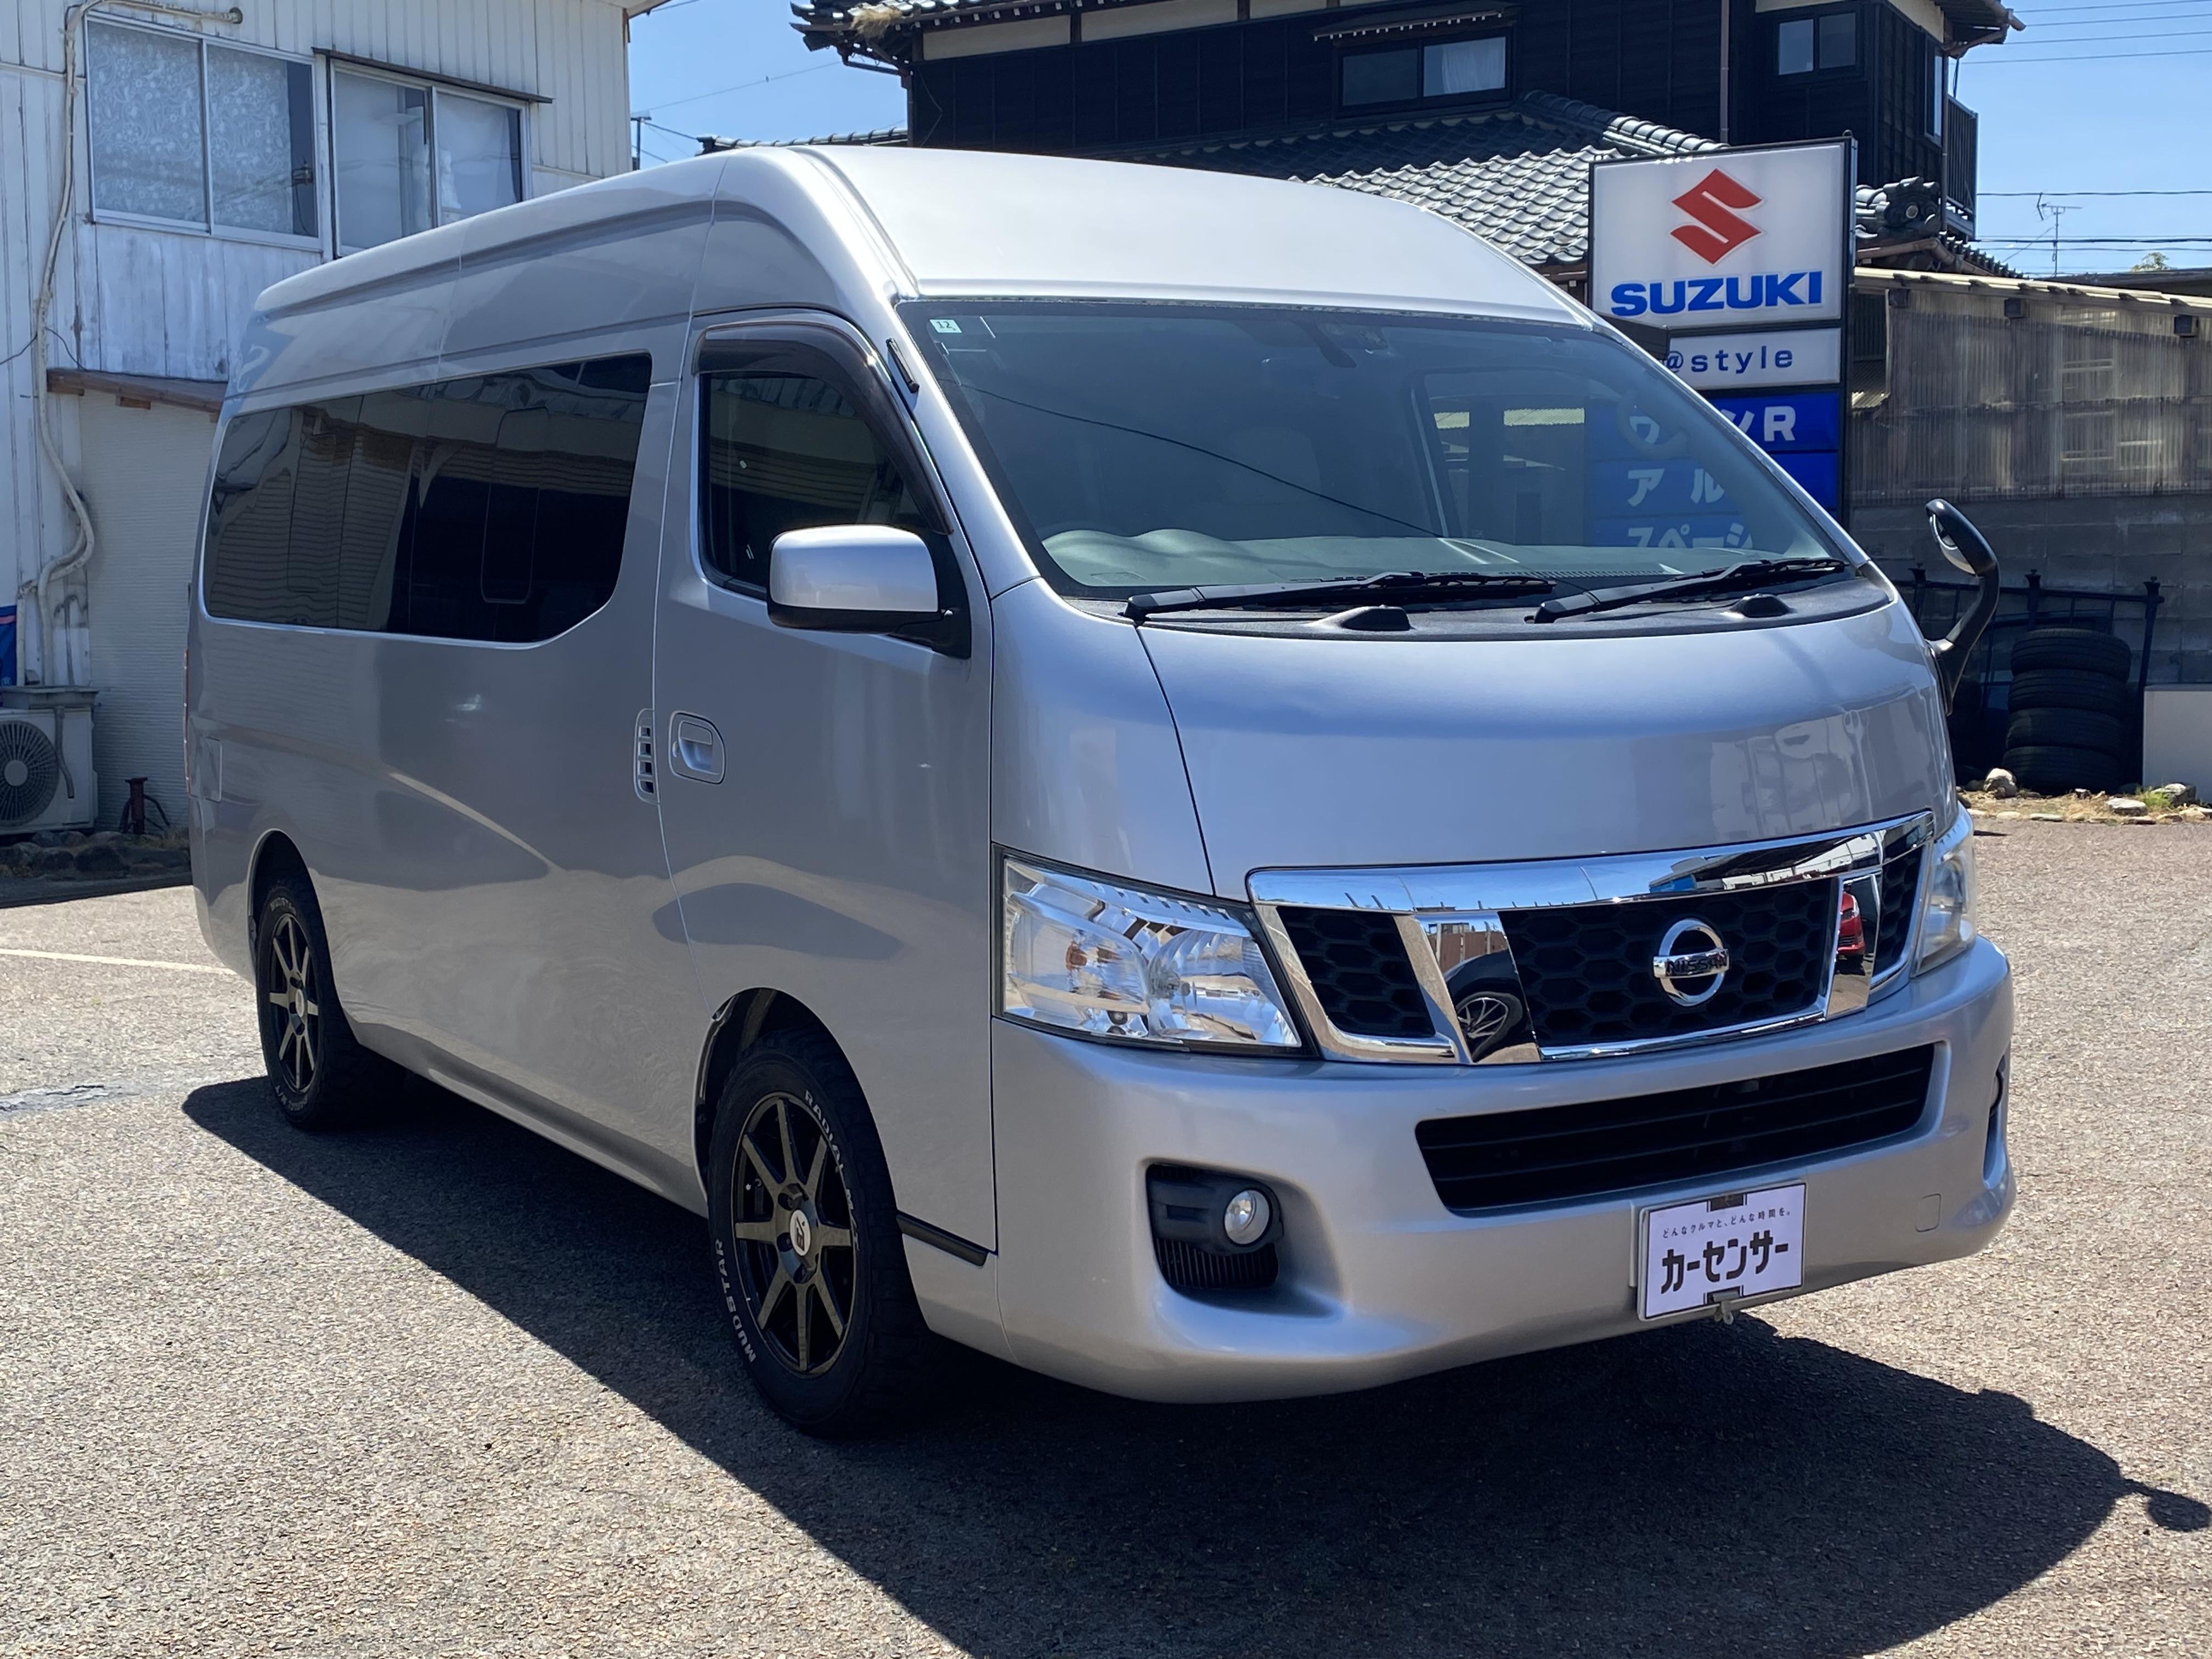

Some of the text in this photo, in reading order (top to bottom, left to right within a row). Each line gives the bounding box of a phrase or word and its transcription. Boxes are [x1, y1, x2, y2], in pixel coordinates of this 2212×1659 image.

[1611, 270, 1822, 317] SUZUKI
[1667, 346, 1793, 374] @style
[1666, 952, 1728, 977] NISSAN
[1662, 1207, 1791, 1239] どんなクルマと、どんな時間を。
[1661, 1229, 1788, 1294] カーセンサー
[714, 1239, 757, 1363] MUDSTAR
